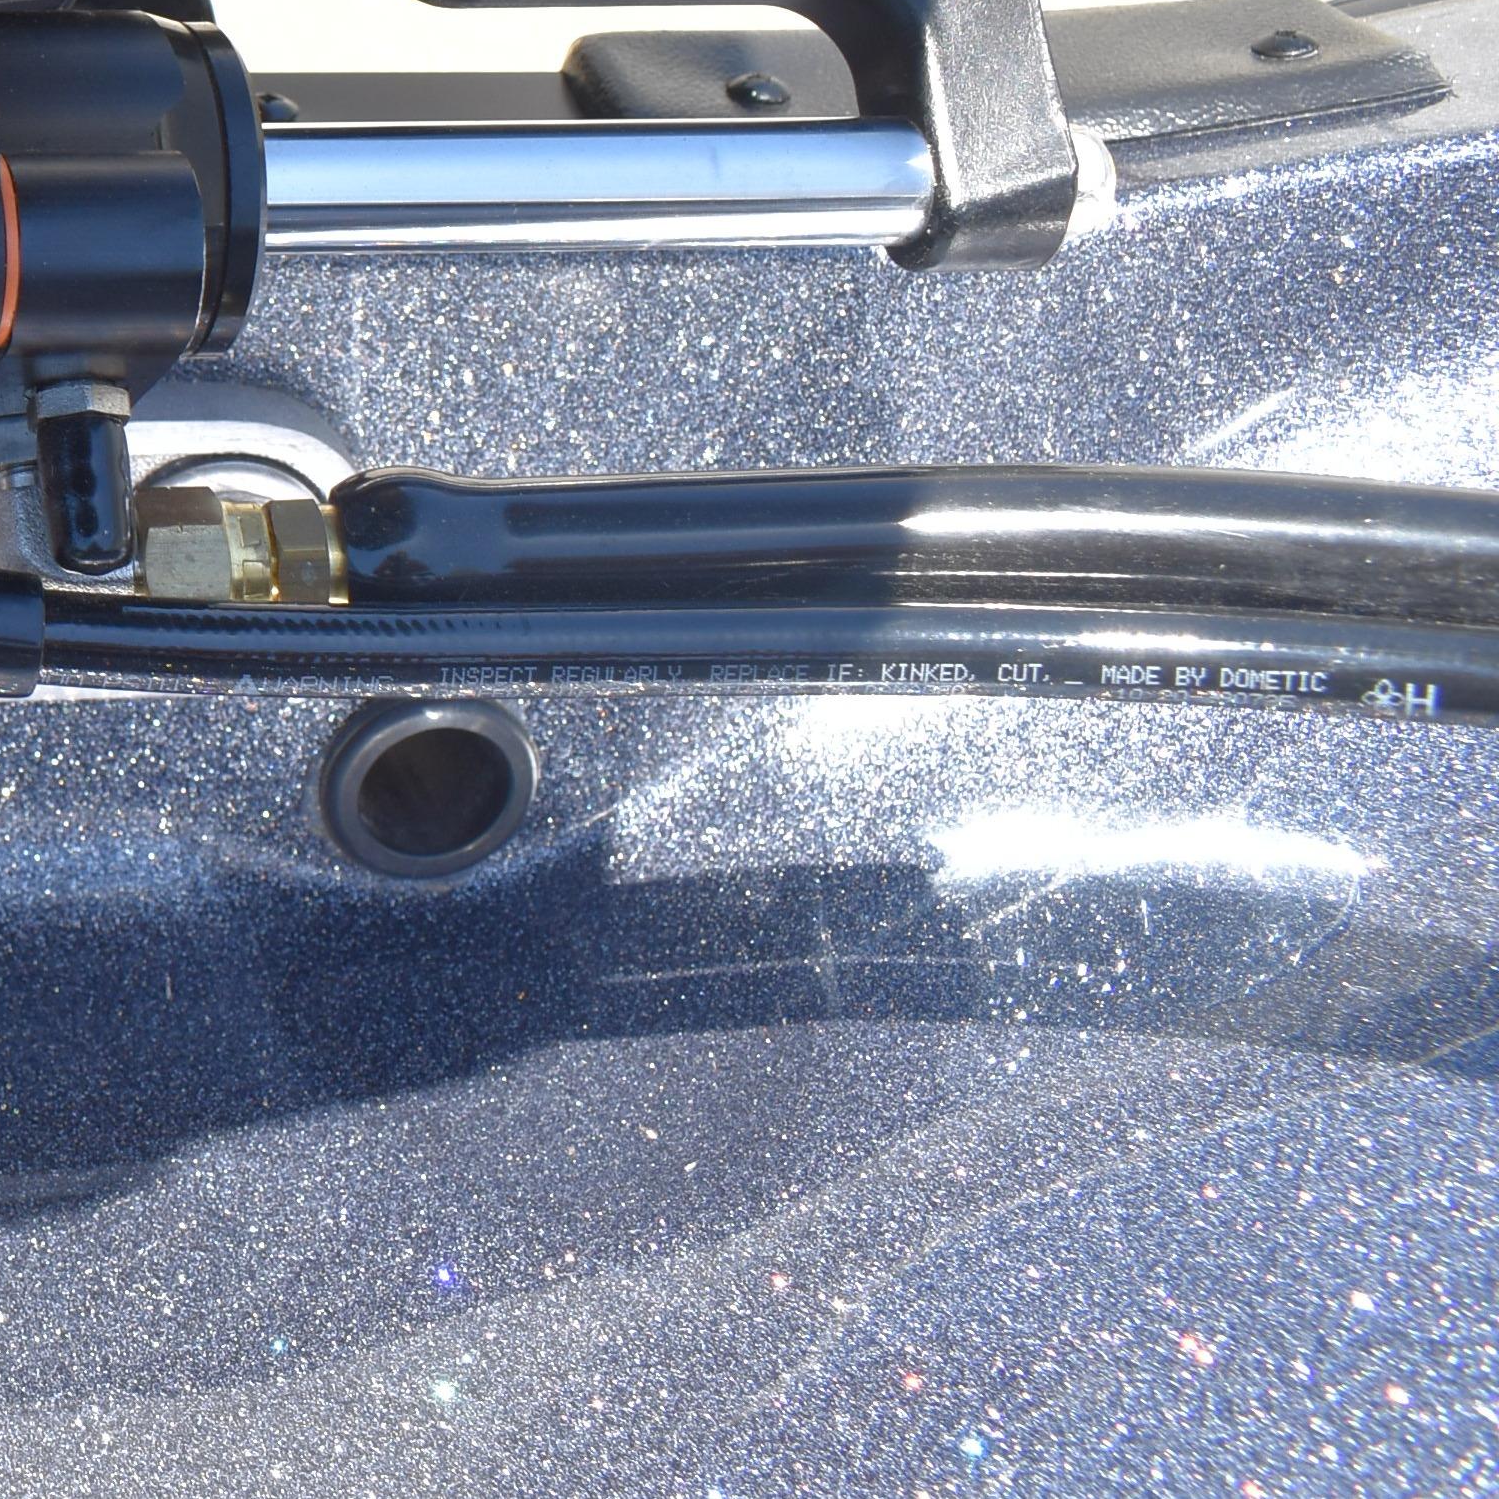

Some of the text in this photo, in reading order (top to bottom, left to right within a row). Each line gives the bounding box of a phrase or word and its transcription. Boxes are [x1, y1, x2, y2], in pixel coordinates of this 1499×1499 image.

[440, 666, 537, 685] INSPECT
[710, 664, 809, 683] REPLACE
[827, 663, 864, 682] IF:
[881, 663, 976, 683] KINKED,
[997, 662, 1051, 684] CUT,
[1101, 664, 1163, 686] MADE
[1175, 666, 1209, 687] BY
[1219, 667, 1330, 693] DOMETIC
